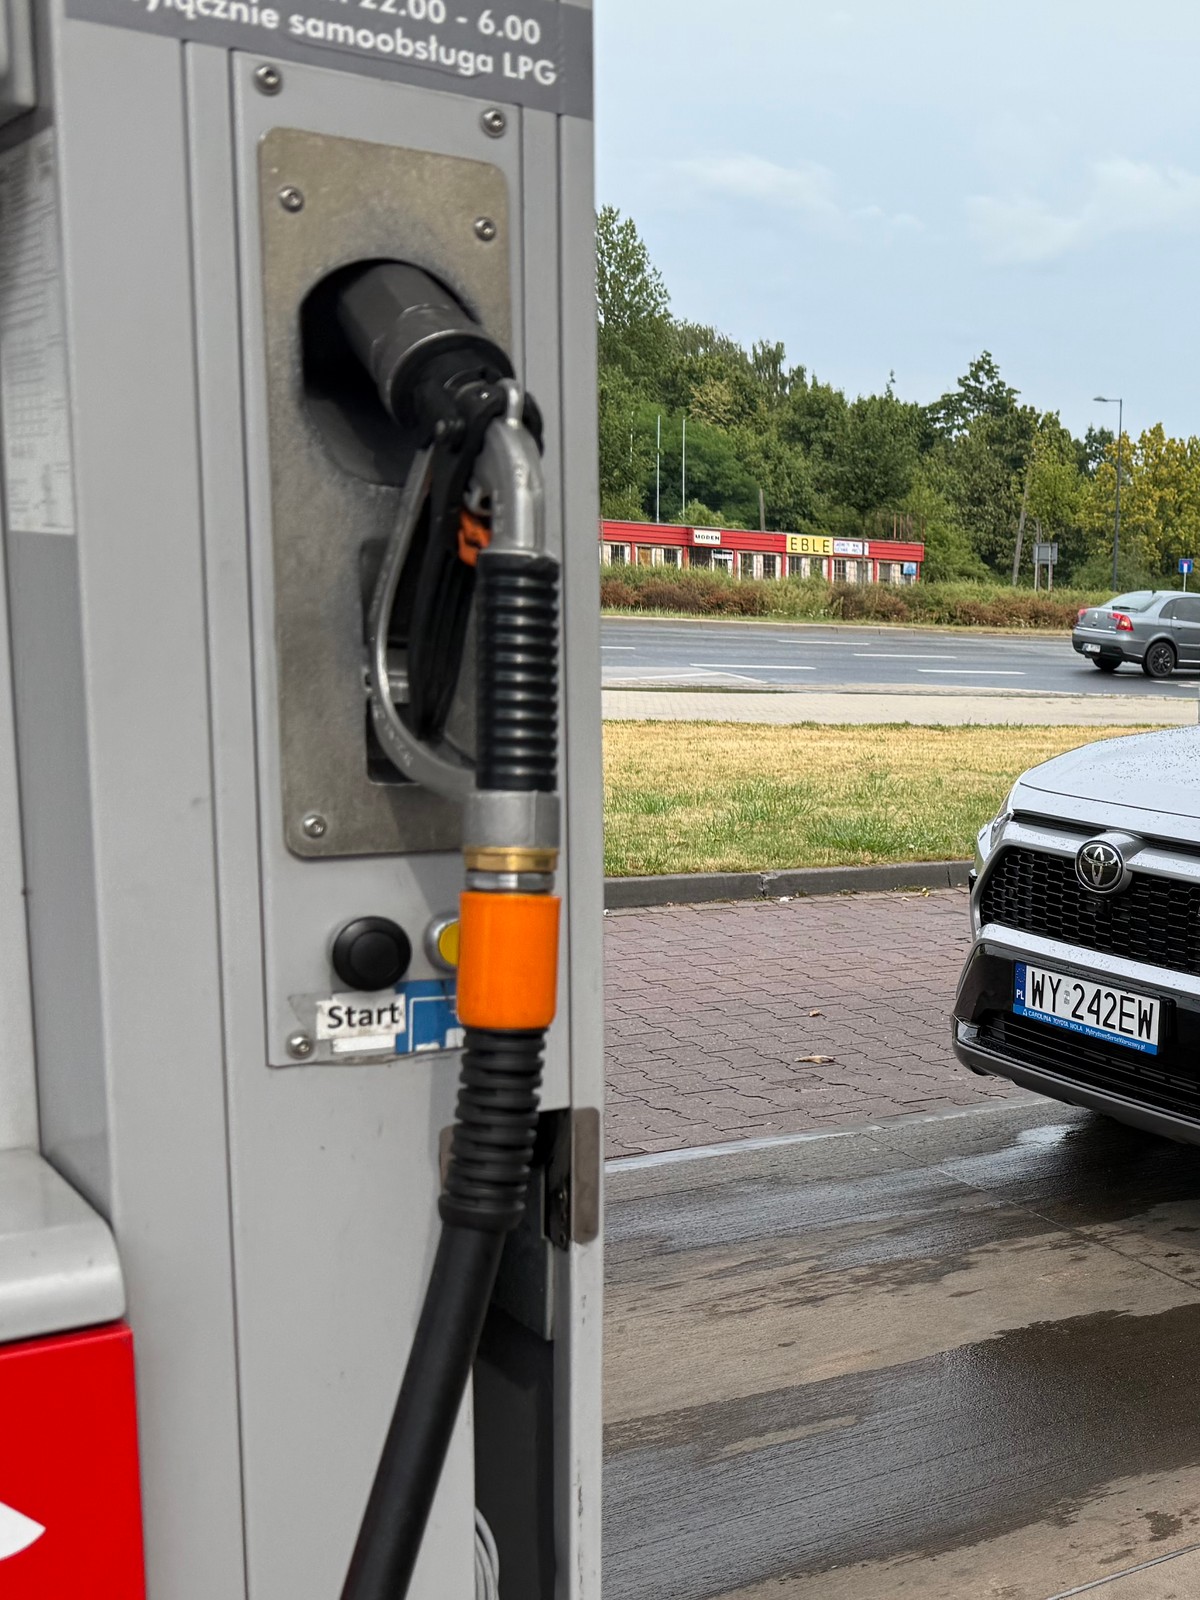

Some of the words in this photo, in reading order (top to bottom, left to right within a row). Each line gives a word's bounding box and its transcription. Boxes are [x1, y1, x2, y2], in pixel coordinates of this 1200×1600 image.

[477, 7, 542, 45] 6.00
[289, 14, 493, 77] samoobsługa
[502, 51, 558, 86] LPG
[790, 537, 830, 553] EBLE
[1016, 989, 1025, 1000] PL
[1031, 971, 1062, 1013] WY
[1071, 983, 1154, 1040] 242EW
[328, 1002, 399, 1028] Start
[1028, 1011, 1052, 1022] CAROLINA
[1053, 1017, 1069, 1028] TOYOTA
